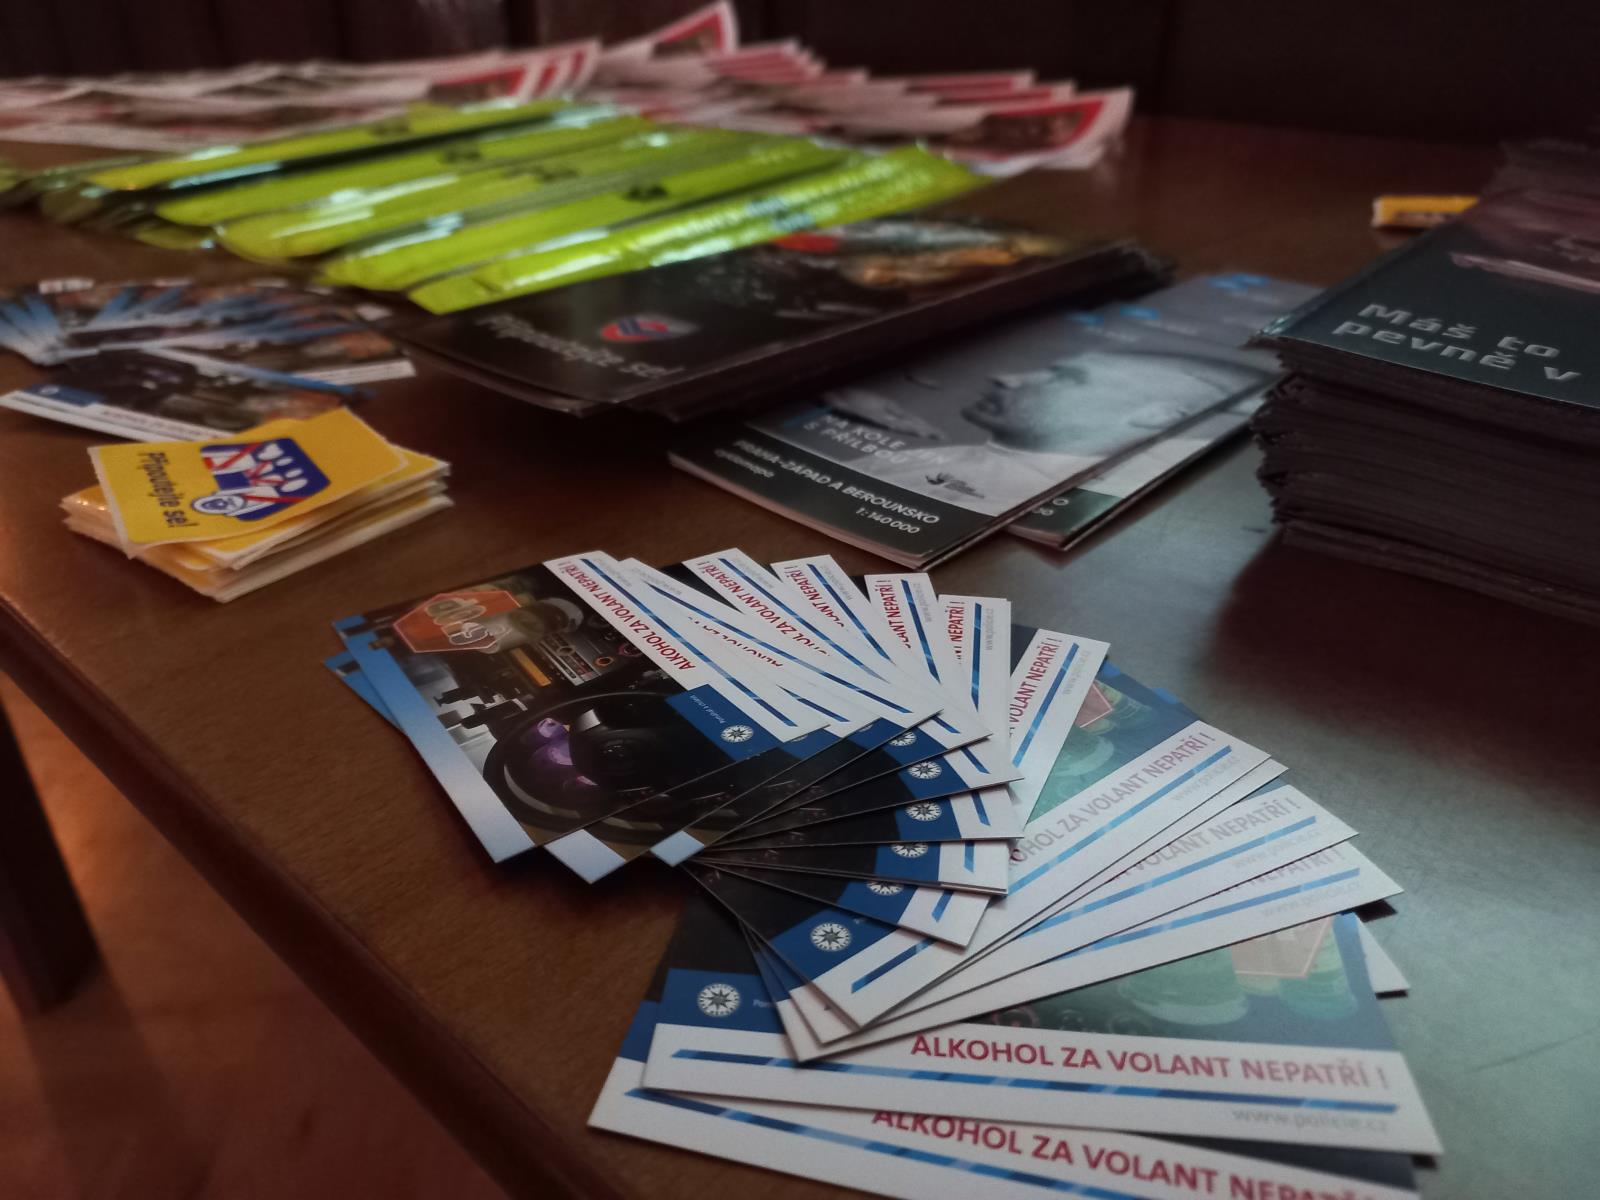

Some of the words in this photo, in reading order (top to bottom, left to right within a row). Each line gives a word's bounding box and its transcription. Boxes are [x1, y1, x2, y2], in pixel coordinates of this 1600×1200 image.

[1357, 303, 1478, 340] Máš
[1497, 336, 1560, 358] to
[1332, 321, 1518, 370] pevně
[1543, 366, 1582, 381] v
[842, 485, 940, 524] BEROUNSKO
[785, 570, 821, 600] NEPATŘÍ
[875, 584, 901, 618] NEPATŘÍ
[593, 588, 635, 623] VOLANT
[736, 590, 781, 623] VOLANT
[945, 605, 965, 642] NEPATŘÍ
[629, 619, 650, 634] ZA
[776, 621, 797, 635] ZA
[642, 632, 696, 670] ALKOHOL
[1009, 681, 1038, 723] VOLANT
[1025, 642, 1061, 681] NEPATŘÍ
[1057, 813, 1089, 833] ZA
[1086, 775, 1147, 817] VOLANT
[1142, 731, 1208, 779] NEPATŘÍ
[1209, 799, 1290, 841] NEPATŘÍ
[911, 1034, 1054, 1066] ALKOHOL
[1061, 1047, 1101, 1070] ZA
[1107, 1050, 1230, 1078] VOLANT
[1240, 1057, 1369, 1087] NEPATŘÍ
[872, 1110, 1022, 1155] ALKOHOL
[1032, 1135, 1074, 1165] ZA
[1082, 1144, 1218, 1195] VOLANT
